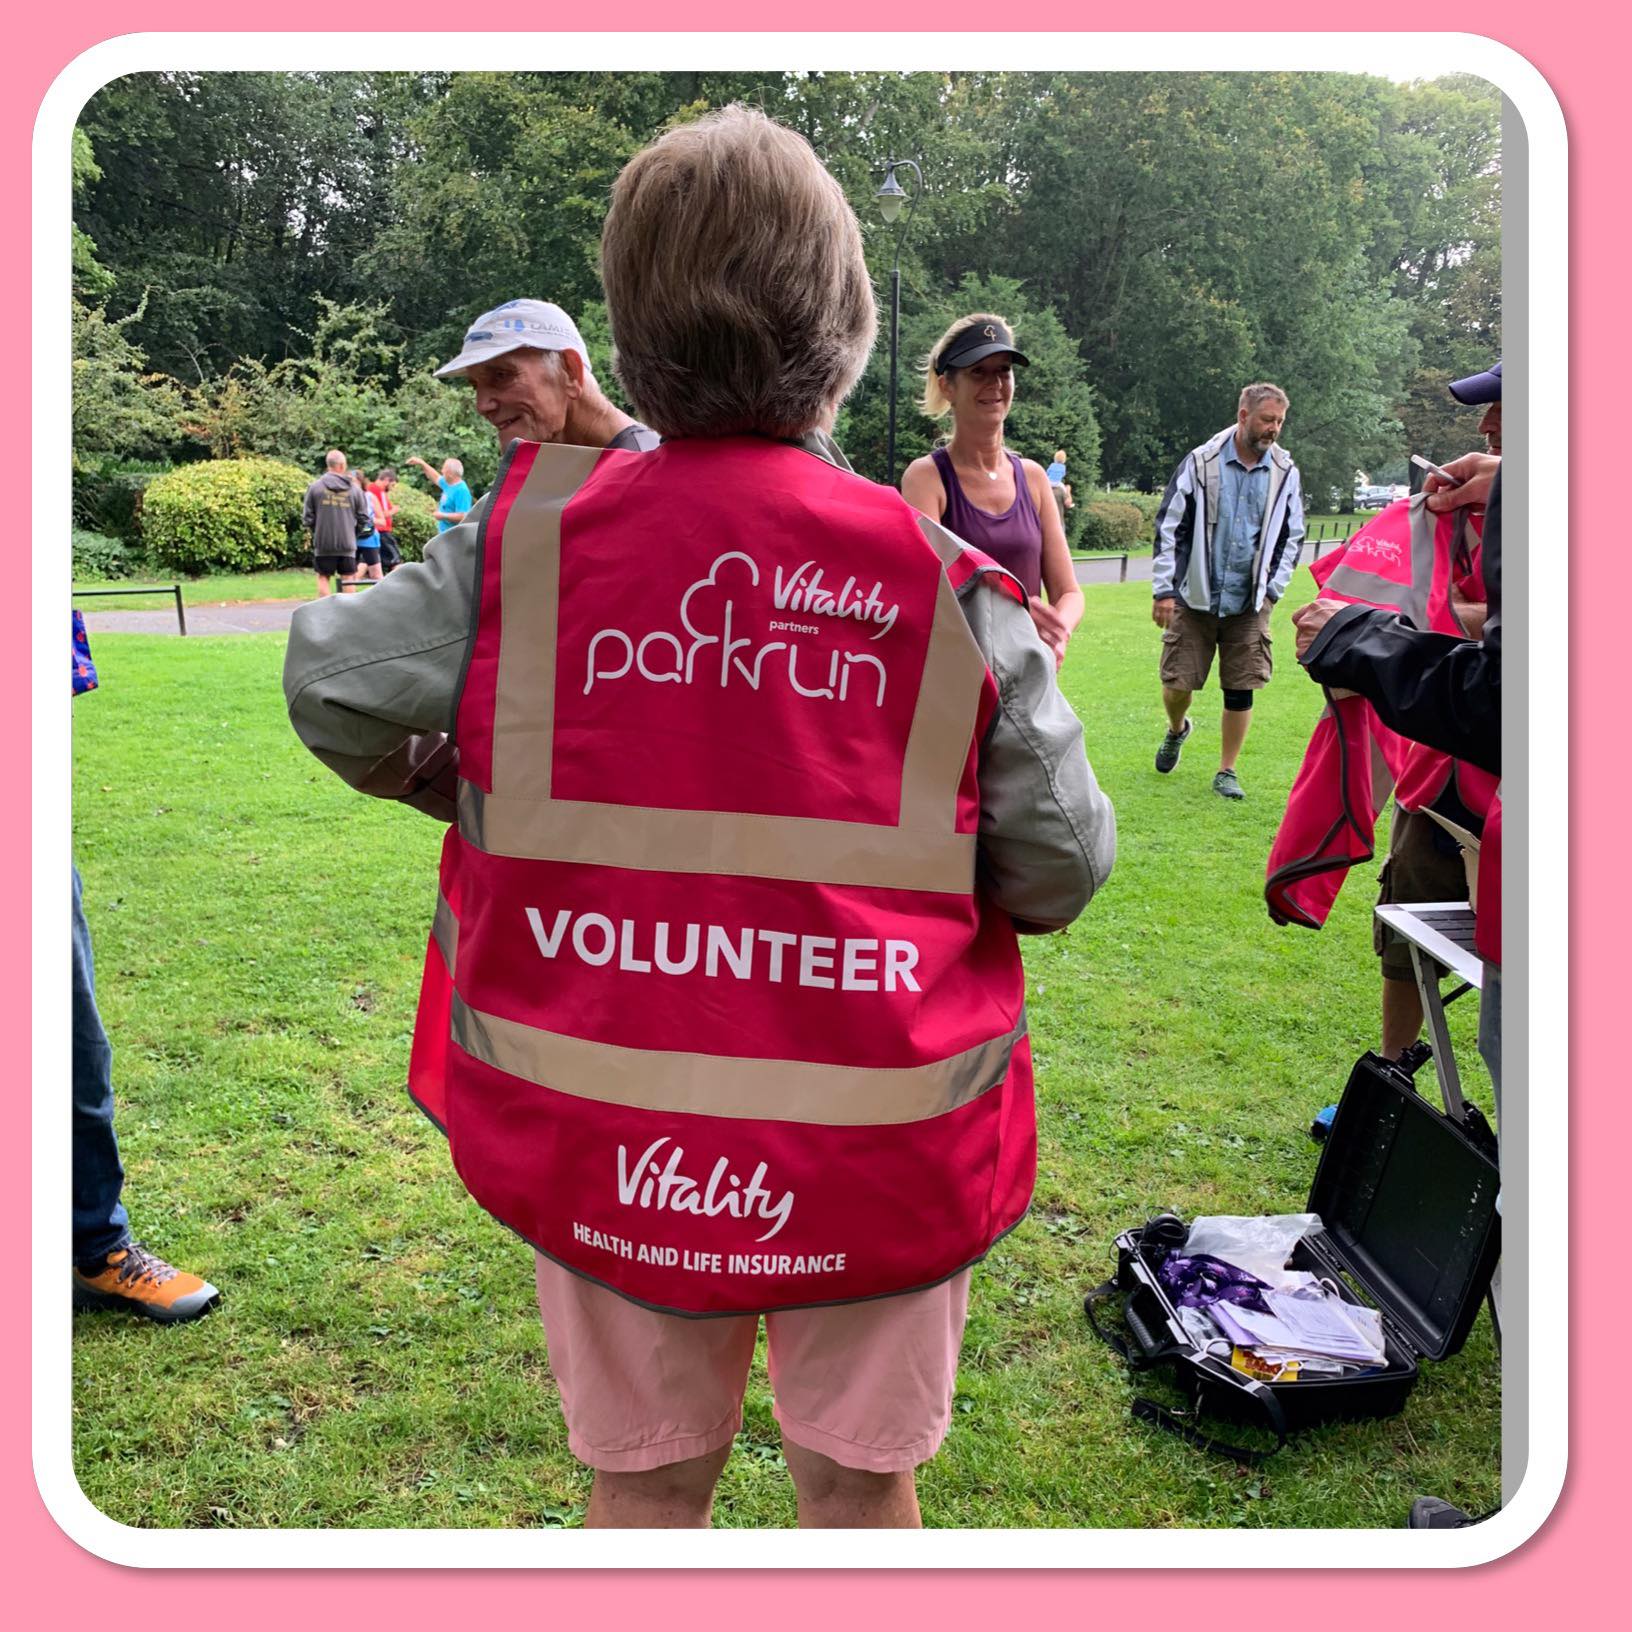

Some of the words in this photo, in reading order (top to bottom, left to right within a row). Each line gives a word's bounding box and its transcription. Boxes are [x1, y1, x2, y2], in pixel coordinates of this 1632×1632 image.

[769, 619, 820, 635] partners
[773, 560, 900, 641] Vitality
[582, 598, 887, 707] parkrun
[524, 907, 923, 993] VOLUNTEER
[617, 1136, 795, 1242] Vitality
[573, 1221, 633, 1259] HEALTH
[636, 1244, 679, 1267] AND
[682, 1250, 722, 1273] LIFE
[728, 1253, 847, 1275] INSURANCE
